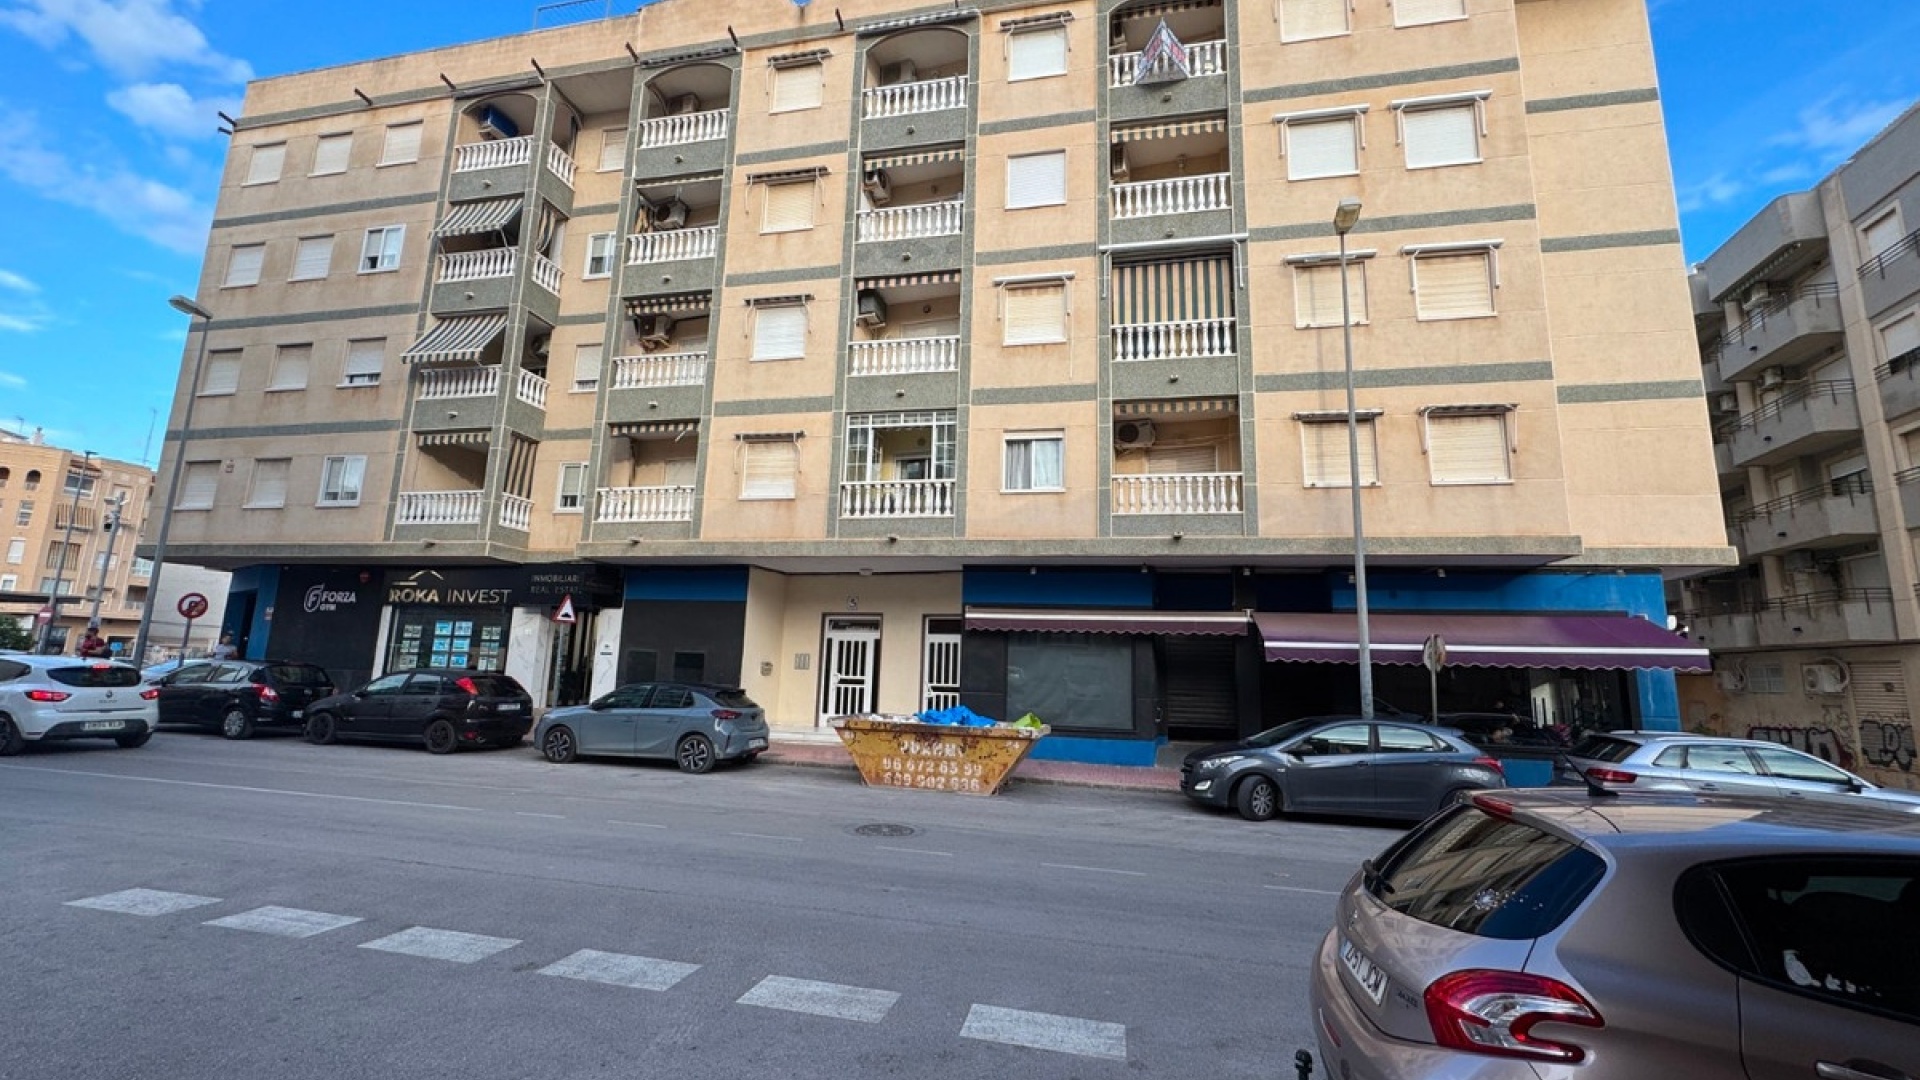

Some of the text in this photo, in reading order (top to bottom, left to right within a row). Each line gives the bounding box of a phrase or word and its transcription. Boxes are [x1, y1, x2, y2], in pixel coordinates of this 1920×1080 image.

[321, 590, 356, 603] FORZA
[388, 588, 512, 603] ROKA INVEST
[907, 758, 935, 773] 672
